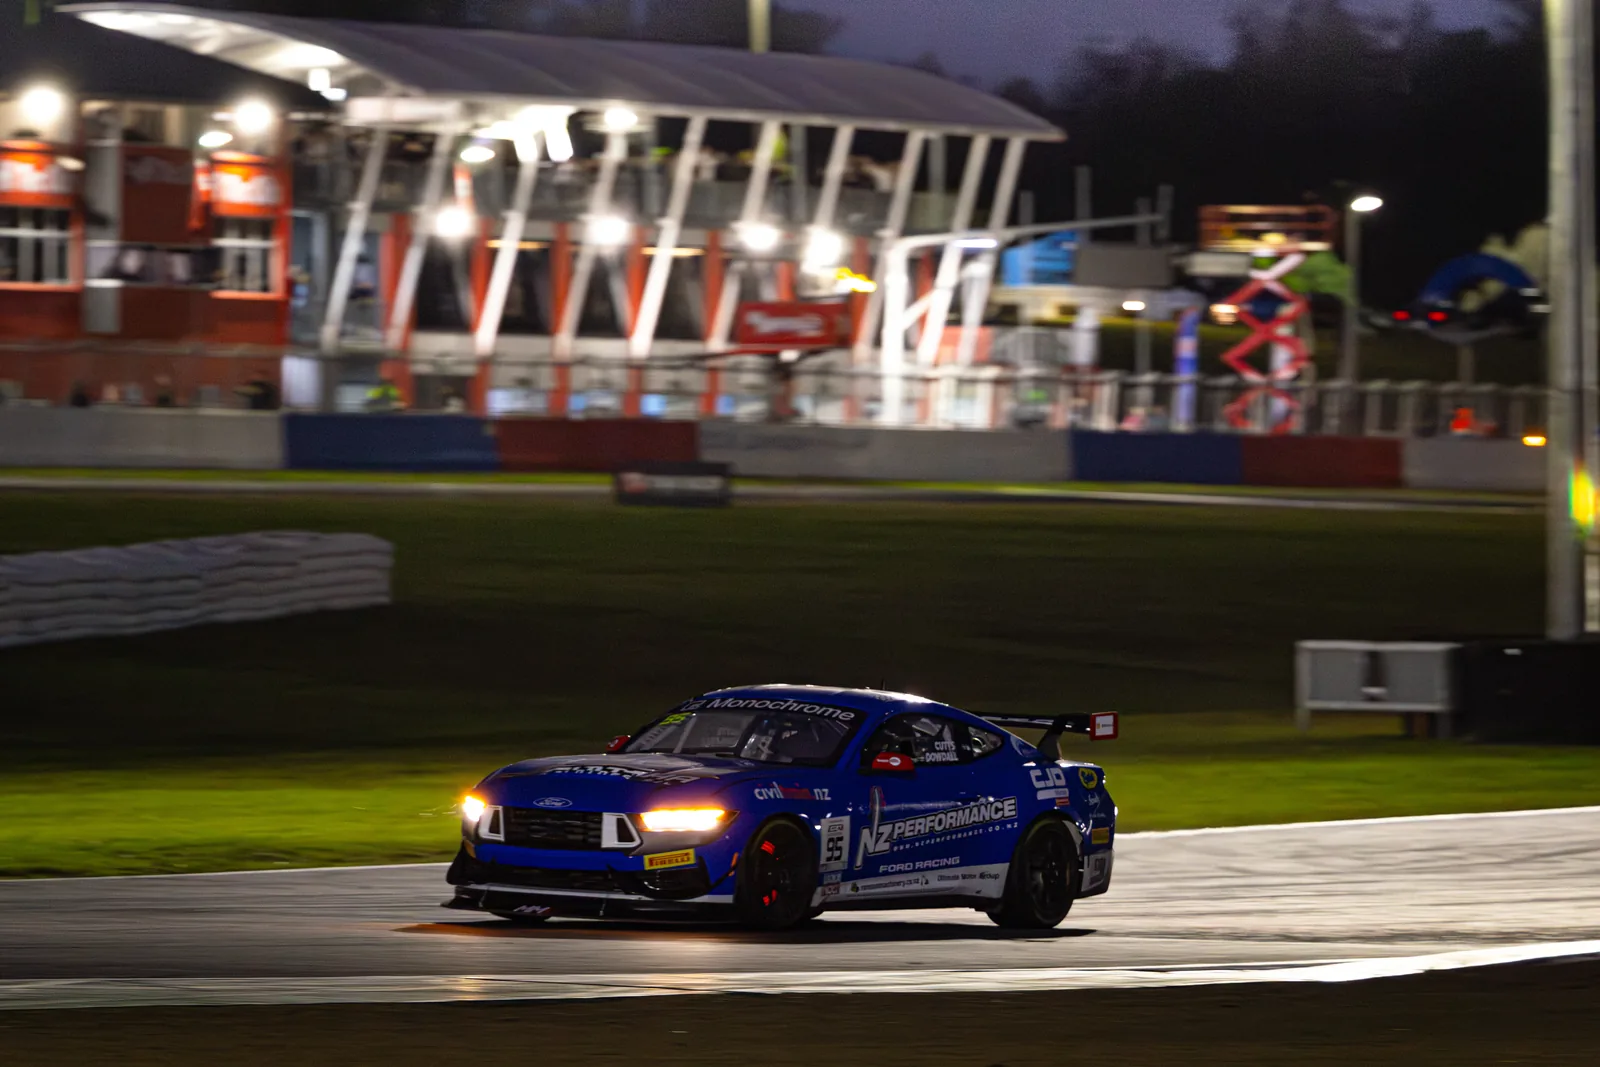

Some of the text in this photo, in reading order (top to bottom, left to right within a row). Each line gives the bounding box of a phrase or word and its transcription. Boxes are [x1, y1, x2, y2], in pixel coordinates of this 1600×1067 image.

[706, 698, 856, 721] Monochrome
[934, 741, 956, 751] CUTTS
[1029, 767, 1066, 789] CJD
[892, 798, 1017, 840] PERFORMANCE
[648, 852, 691, 868] PIRELLI
[826, 836, 845, 862] 95
[879, 856, 961, 873] FORD RACING
